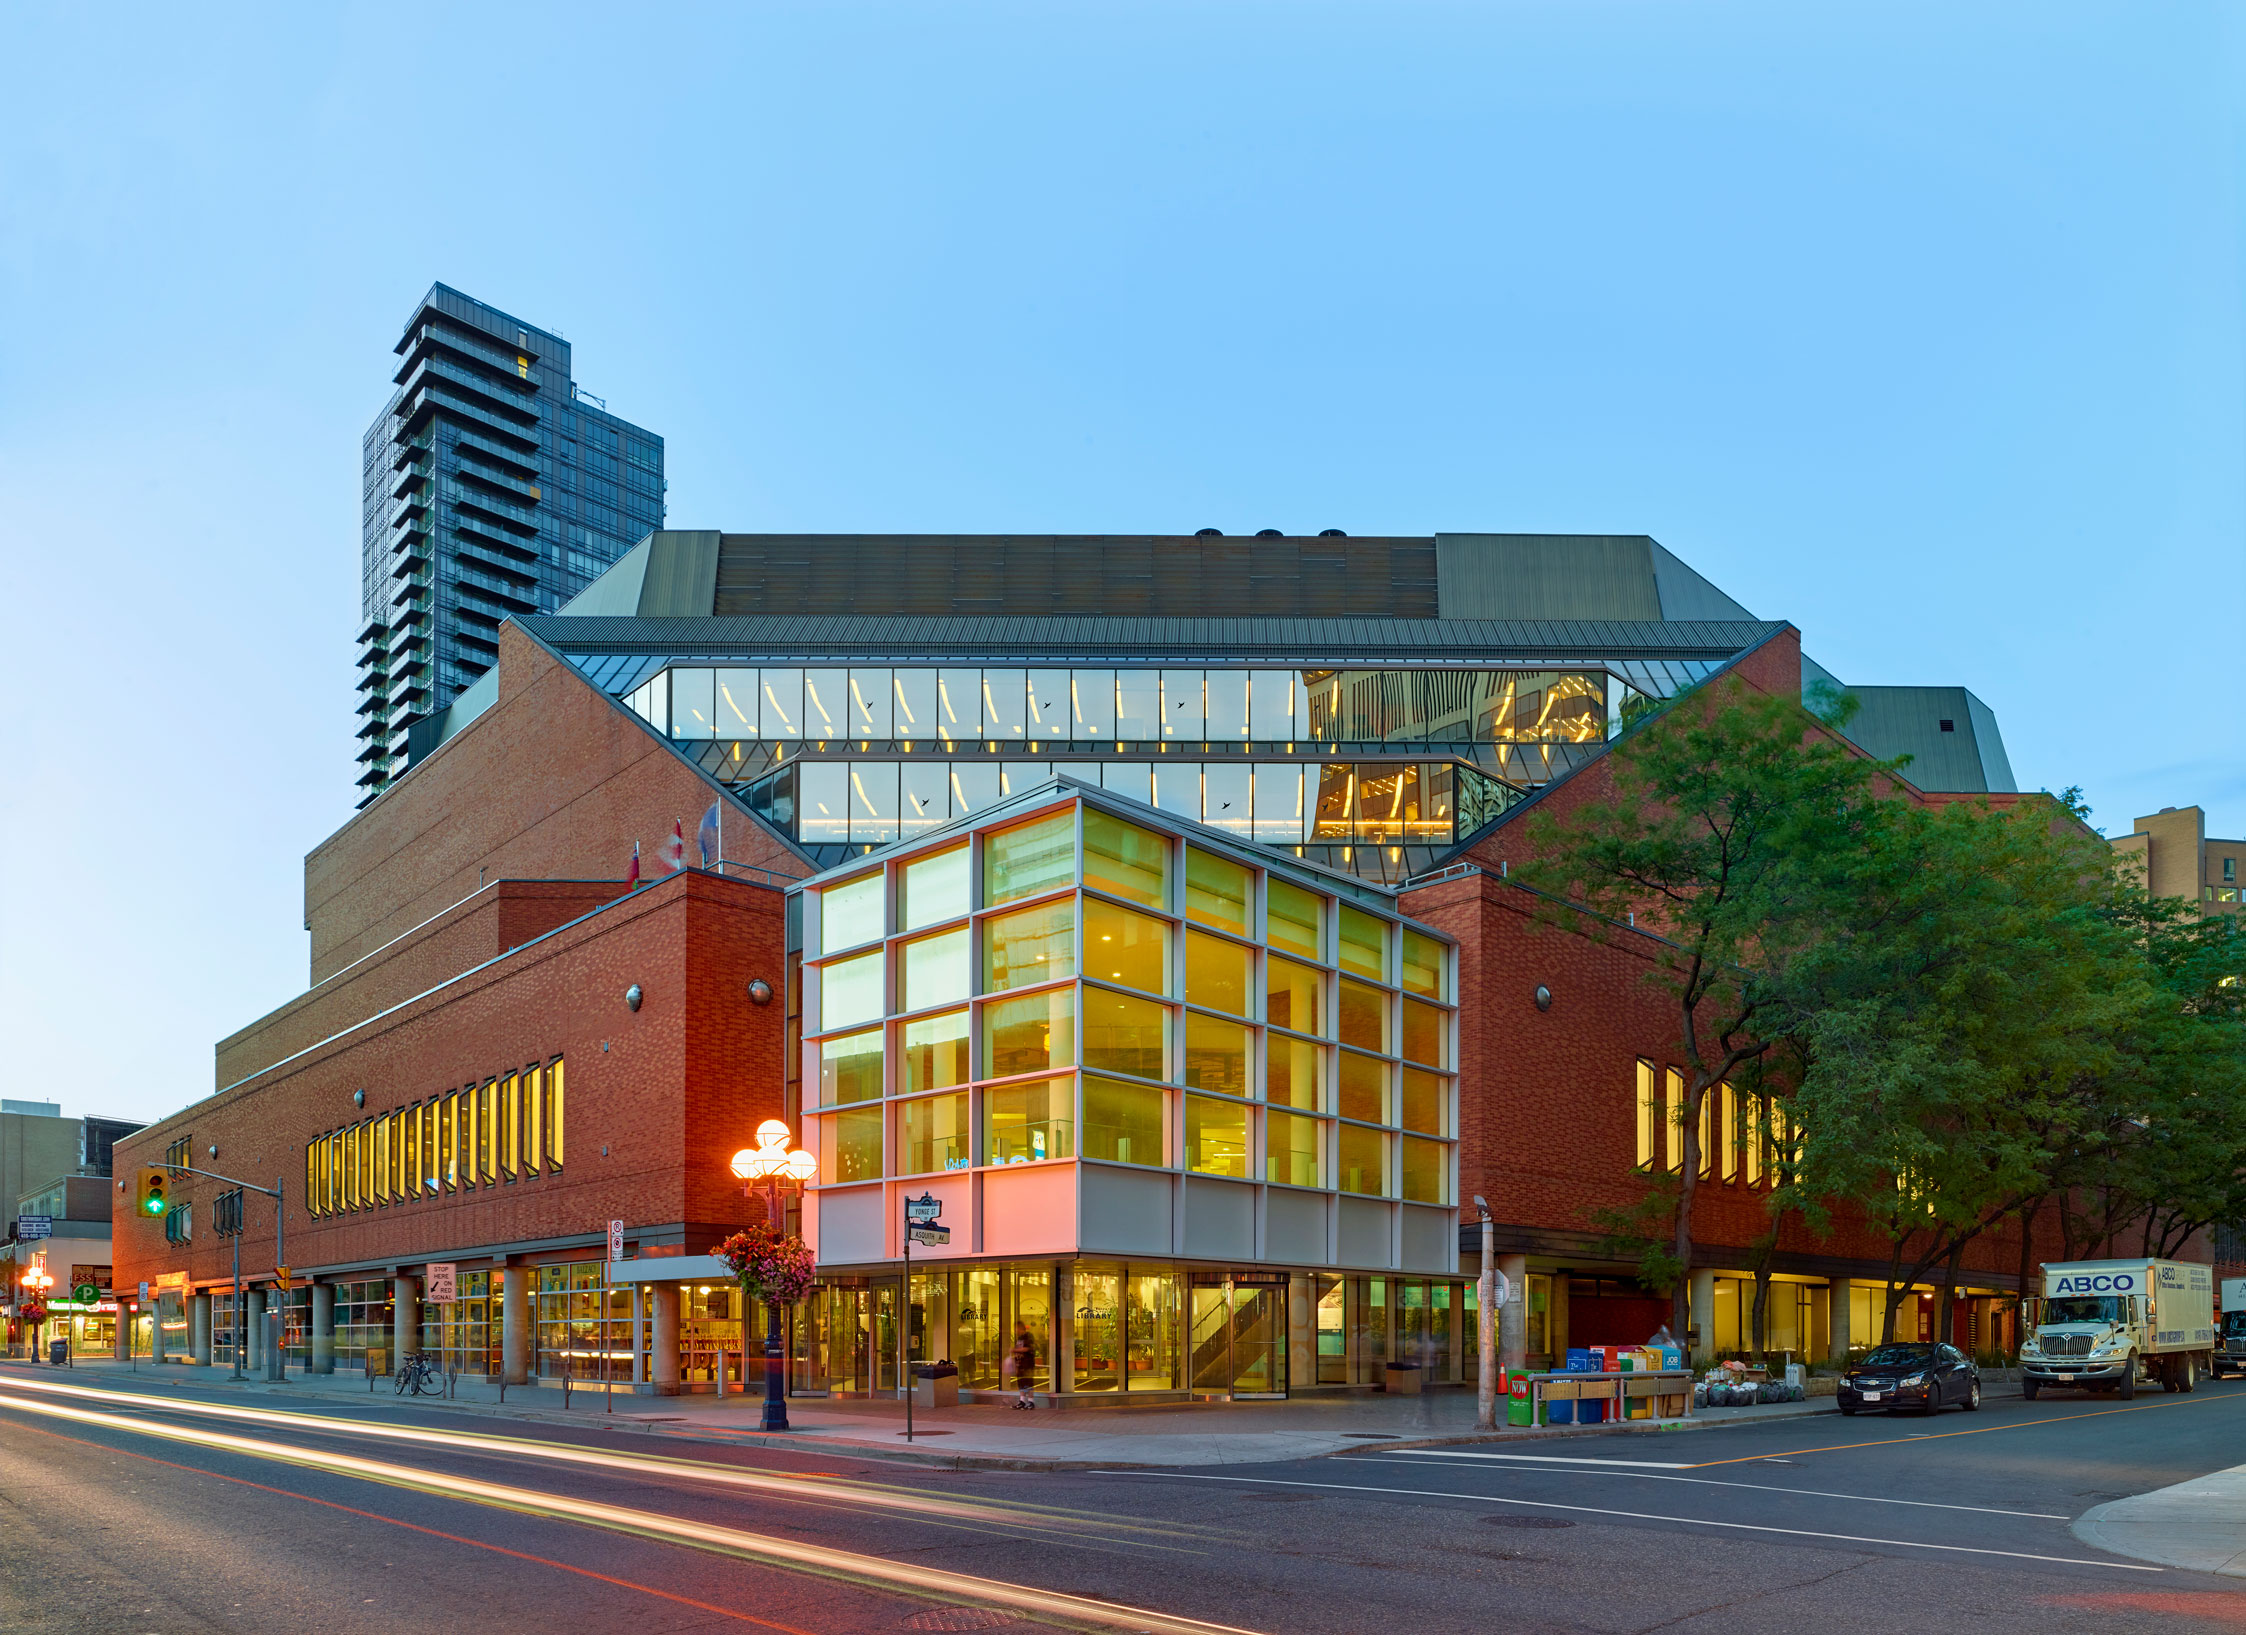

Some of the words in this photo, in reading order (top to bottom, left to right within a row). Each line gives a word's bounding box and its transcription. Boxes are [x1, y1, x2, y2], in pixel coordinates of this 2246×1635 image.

[915, 1231, 935, 1240] ASQUITH
[2162, 1267, 2175, 1281] ABCO
[2056, 1275, 2134, 1293] ABCO
[961, 1312, 988, 1320] LIBRARY
[1076, 1312, 1112, 1320] LIBRARY
[1667, 1356, 1679, 1364] JOB
[1511, 1381, 1528, 1394] NOW
